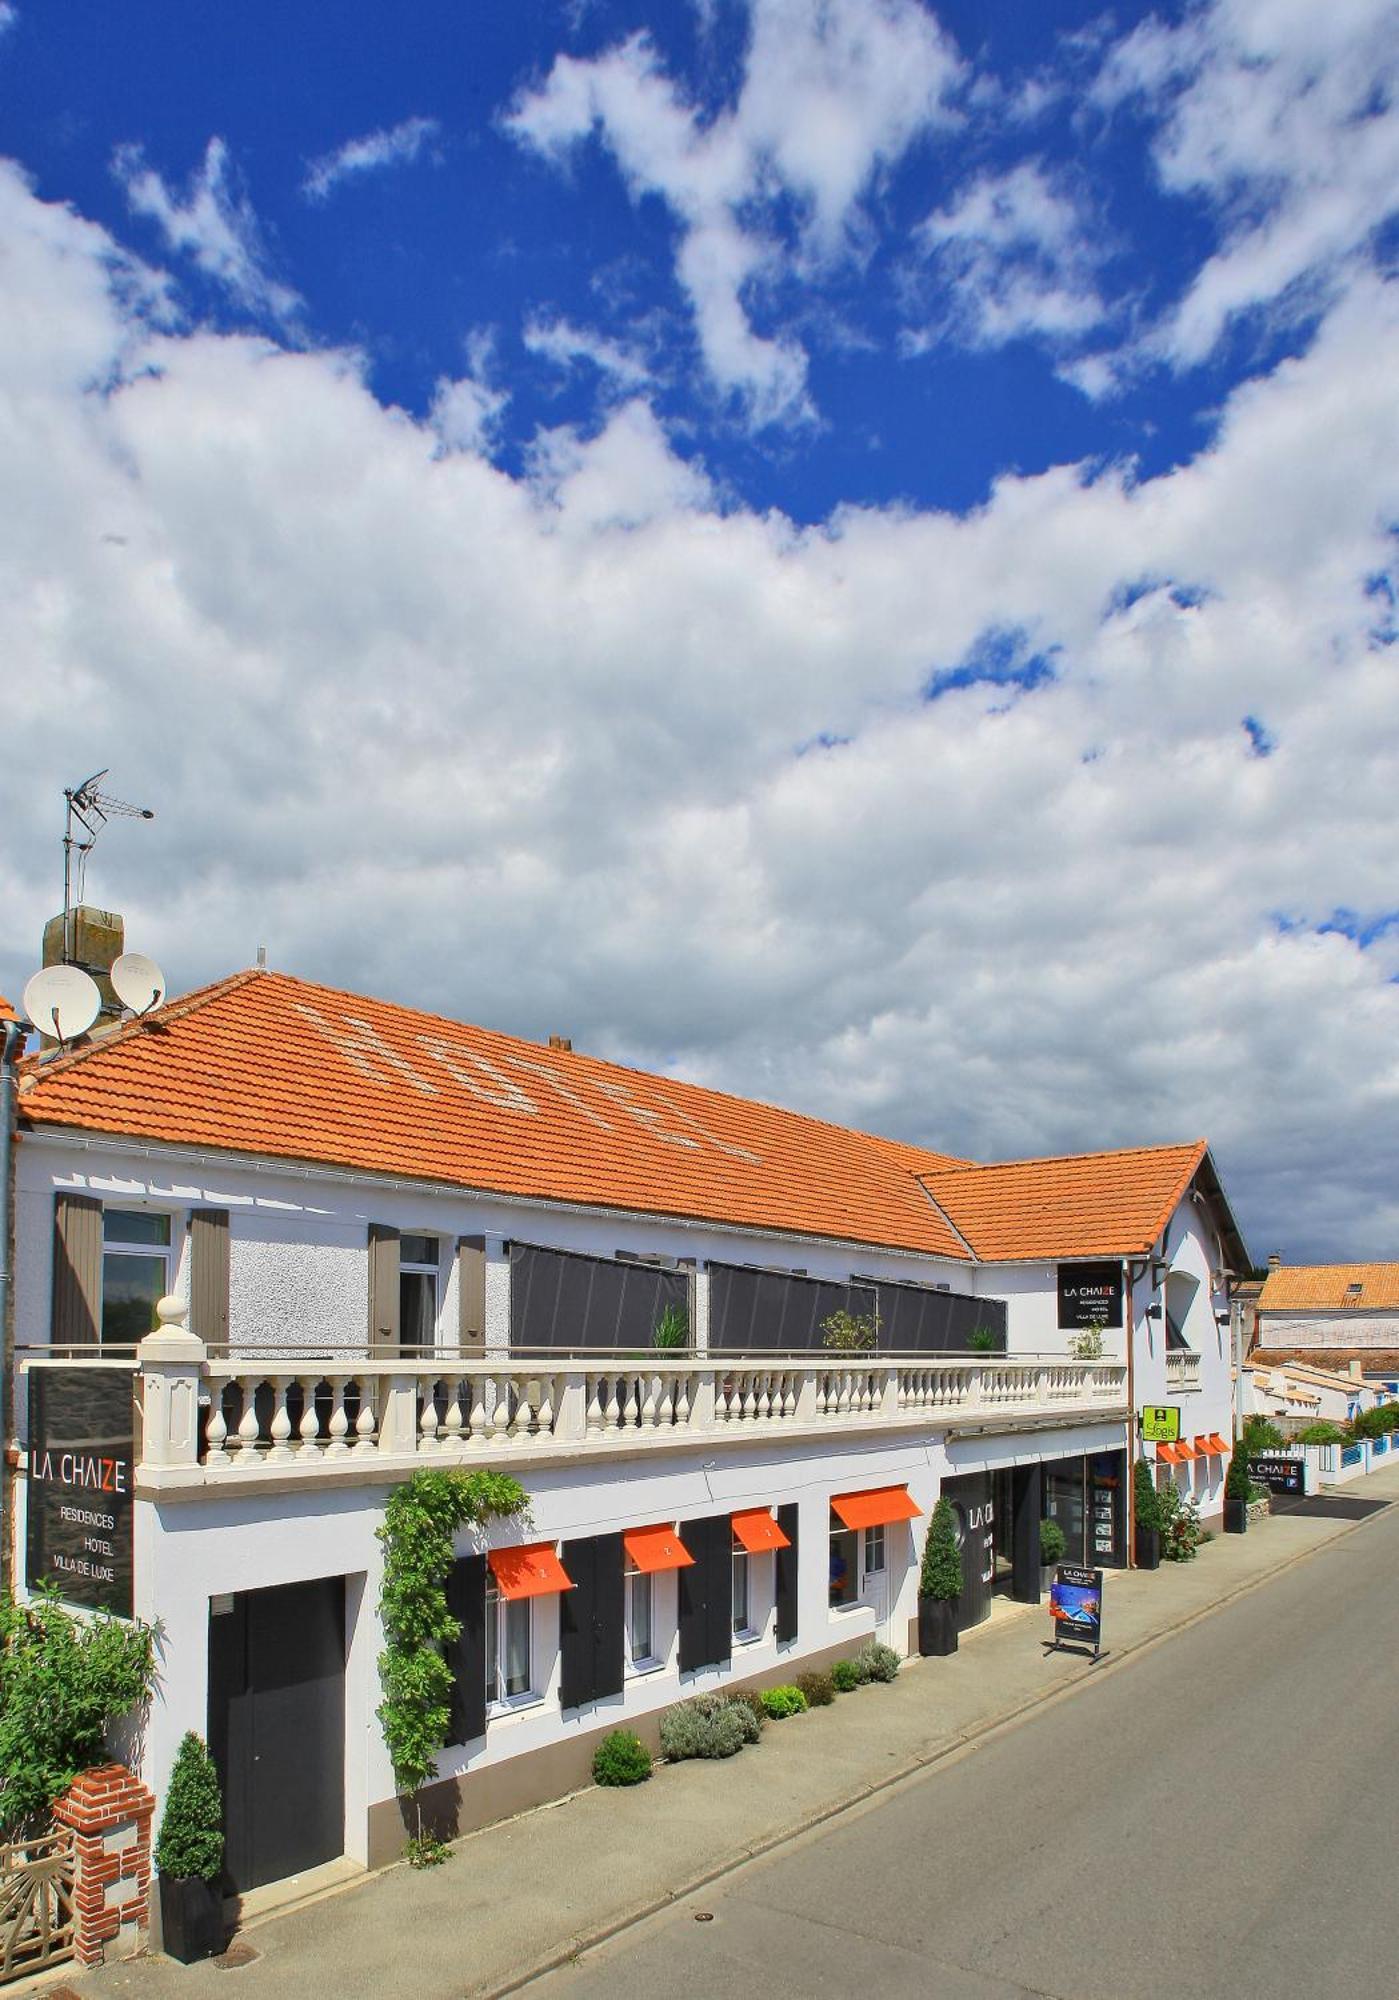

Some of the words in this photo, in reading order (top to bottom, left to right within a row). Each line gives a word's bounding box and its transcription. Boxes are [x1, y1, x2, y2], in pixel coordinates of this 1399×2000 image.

[293, 1002, 763, 1165] HOTEL
[1063, 1287, 1077, 1297] LA
[1079, 1286, 1115, 1297] CHAIZE
[32, 1450, 54, 1481] LA
[60, 1454, 126, 1493] CHAIZE
[60, 1506, 115, 1530] RESIDENCES
[84, 1537, 115, 1557] HOTEL
[53, 1554, 76, 1573] VILLA
[78, 1560, 90, 1577] DE
[91, 1563, 115, 1583] LUXE
